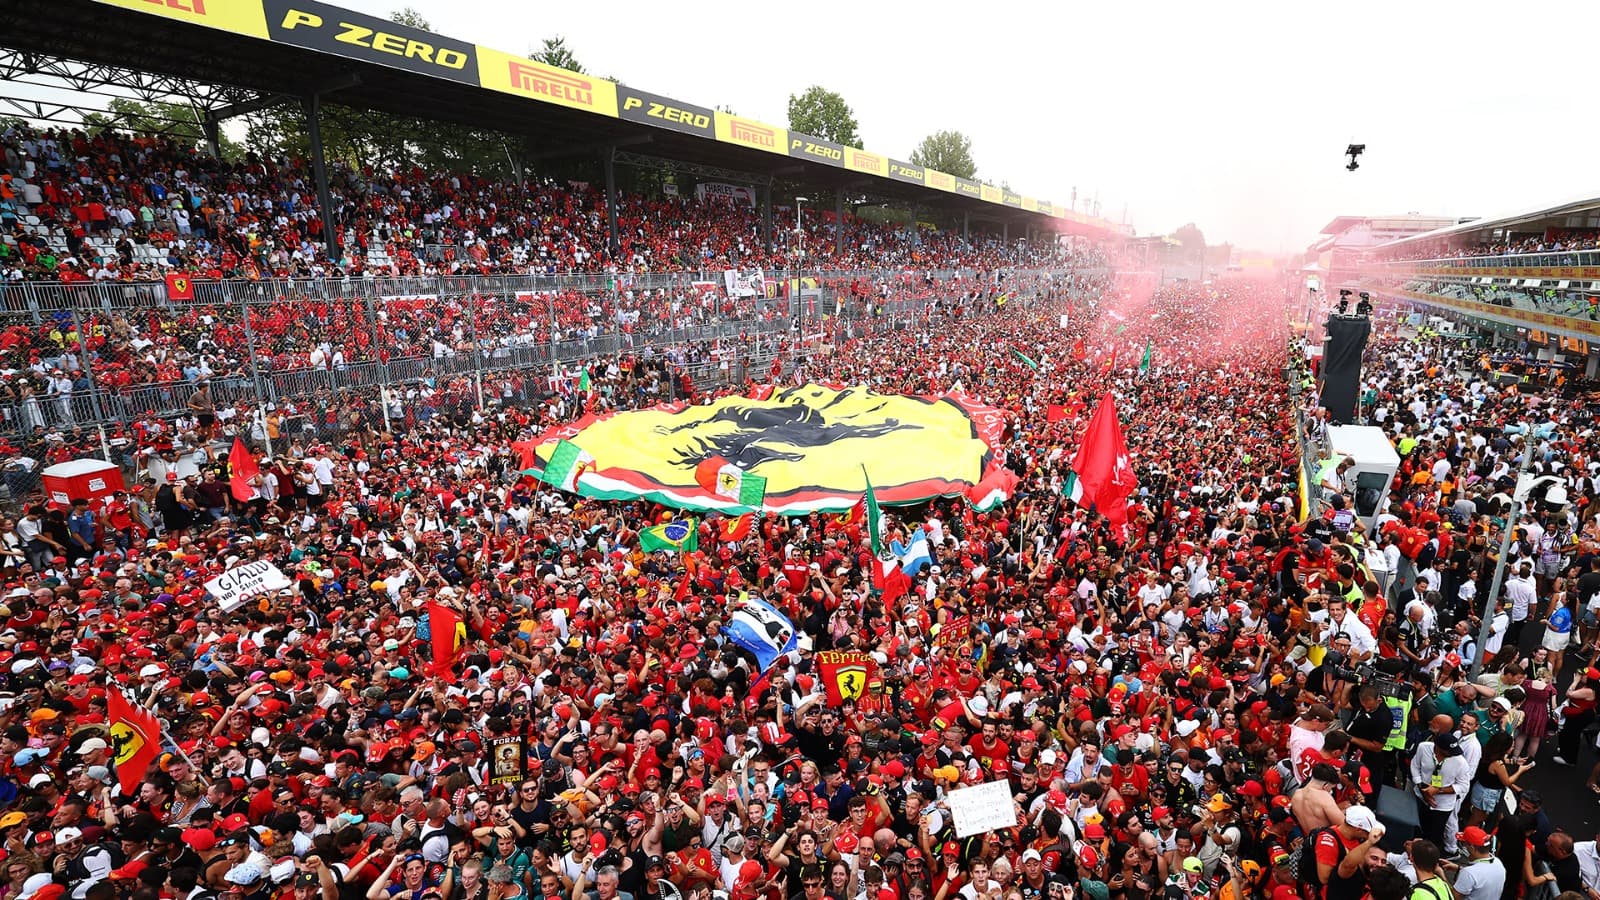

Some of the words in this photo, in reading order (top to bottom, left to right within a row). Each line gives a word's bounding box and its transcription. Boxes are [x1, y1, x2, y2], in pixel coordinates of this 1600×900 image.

[281, 9, 323, 30] P
[334, 22, 467, 70] ZERO
[508, 61, 593, 106] PIRELLI
[623, 97, 642, 111] P
[647, 103, 710, 129] ZERO
[730, 120, 775, 147] PIRELLI
[791, 139, 801, 150] P
[804, 143, 841, 160] ZERO
[891, 164, 898, 173] P
[899, 167, 923, 180] ZERO
[704, 183, 733, 195] CHARLES
[493, 736, 522, 746] FORZA
